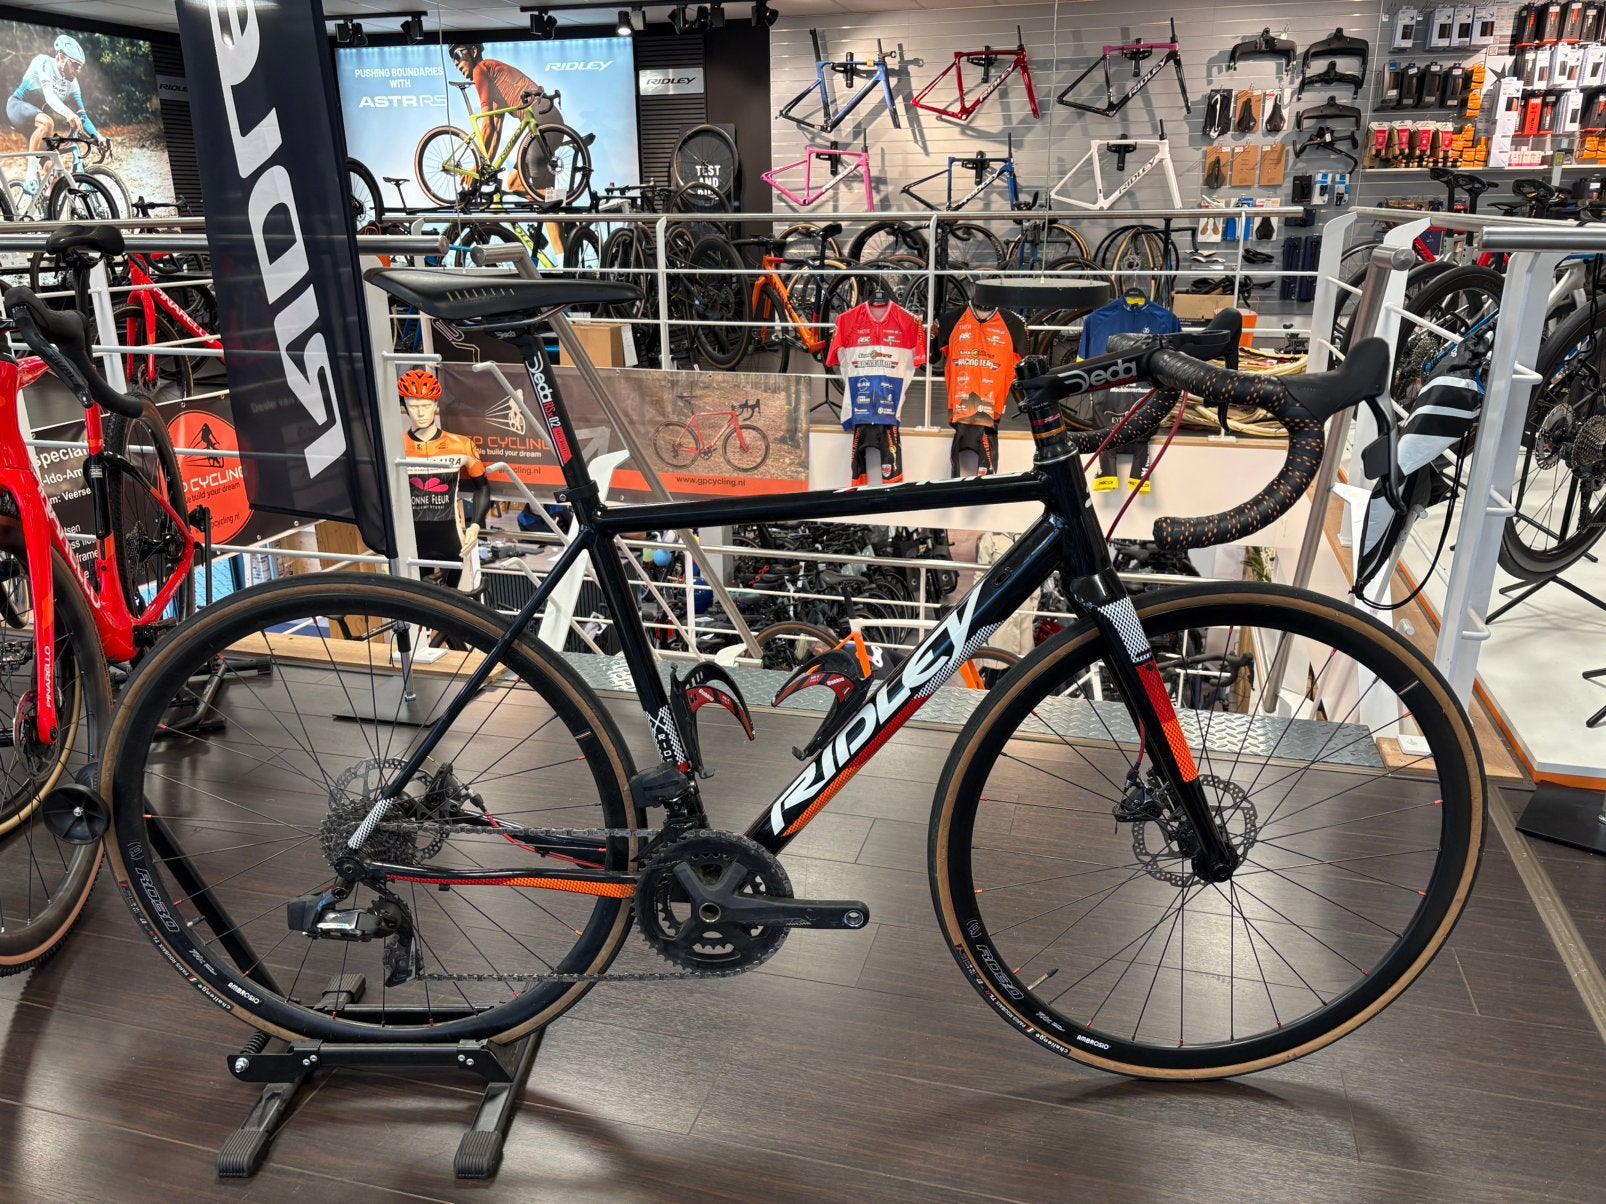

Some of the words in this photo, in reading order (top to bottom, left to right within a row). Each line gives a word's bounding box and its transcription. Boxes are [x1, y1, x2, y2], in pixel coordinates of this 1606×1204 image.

[354, 68, 390, 78] PUSHING
[391, 66, 444, 77] BOUNDARIES
[545, 60, 614, 72] RIDLEY
[389, 79, 411, 88] WITH
[646, 77, 697, 86] RIDLEY
[1128, 57, 1167, 98] RIDLEY
[159, 83, 188, 93] RIDLE
[695, 165, 721, 176] TEST
[1118, 156, 1156, 194] RIDLEY
[698, 177, 719, 187] AND
[525, 350, 553, 404] Deda
[1057, 359, 1138, 397] Deda
[487, 447, 504, 456] build
[504, 449, 519, 458] your
[519, 449, 542, 458] dream
[676, 475, 746, 488] www.gpcycling.nl
[191, 490, 206, 502] build
[206, 487, 221, 499] your
[222, 482, 241, 493] dream
[431, 494, 450, 503] FLEUR
[770, 580, 985, 836] RIDLEY
[197, 984, 231, 1010] challenge
[227, 981, 261, 1005] AMBROSIO
[1035, 1033, 1069, 1054] challenge
[1076, 1034, 1109, 1050] AMBROSIO
